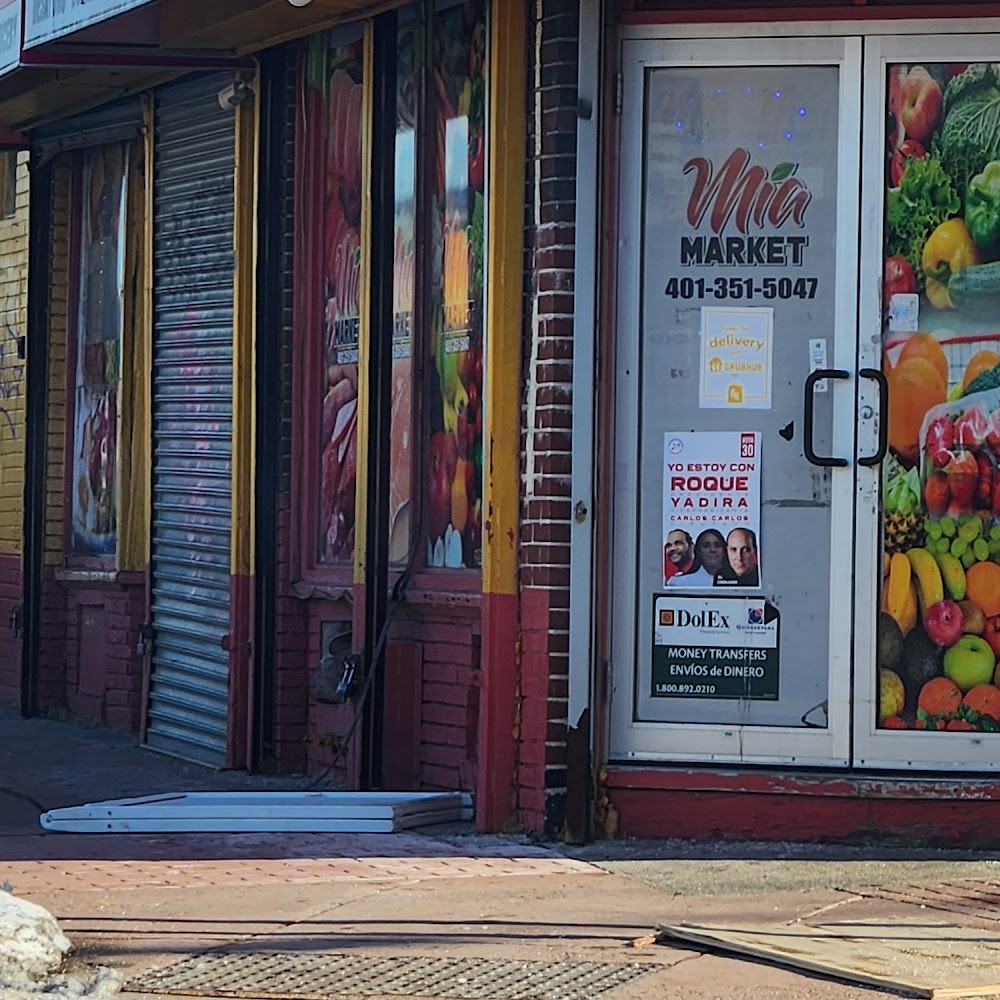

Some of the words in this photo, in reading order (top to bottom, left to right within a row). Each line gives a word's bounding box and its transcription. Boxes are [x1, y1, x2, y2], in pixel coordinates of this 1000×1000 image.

[683, 147, 811, 234] Mia
[680, 236, 809, 266] MARKET
[665, 277, 818, 299] 401-351-5047
[710, 334, 764, 352] delivery
[742, 444, 754, 457] 30
[668, 463, 684, 472] YO
[687, 463, 726, 472] ESTOY
[729, 463, 755, 472] CON
[671, 476, 748, 491] ROQUE
[671, 497, 748, 508] YADIRA
[677, 609, 730, 628] DolEx
[667, 647, 707, 659] MONEY
[709, 648, 767, 660] TRANSFERS
[670, 662, 708, 676] ENVÍOS
[710, 665, 722, 676] de
[724, 666, 764, 677] DINERO
